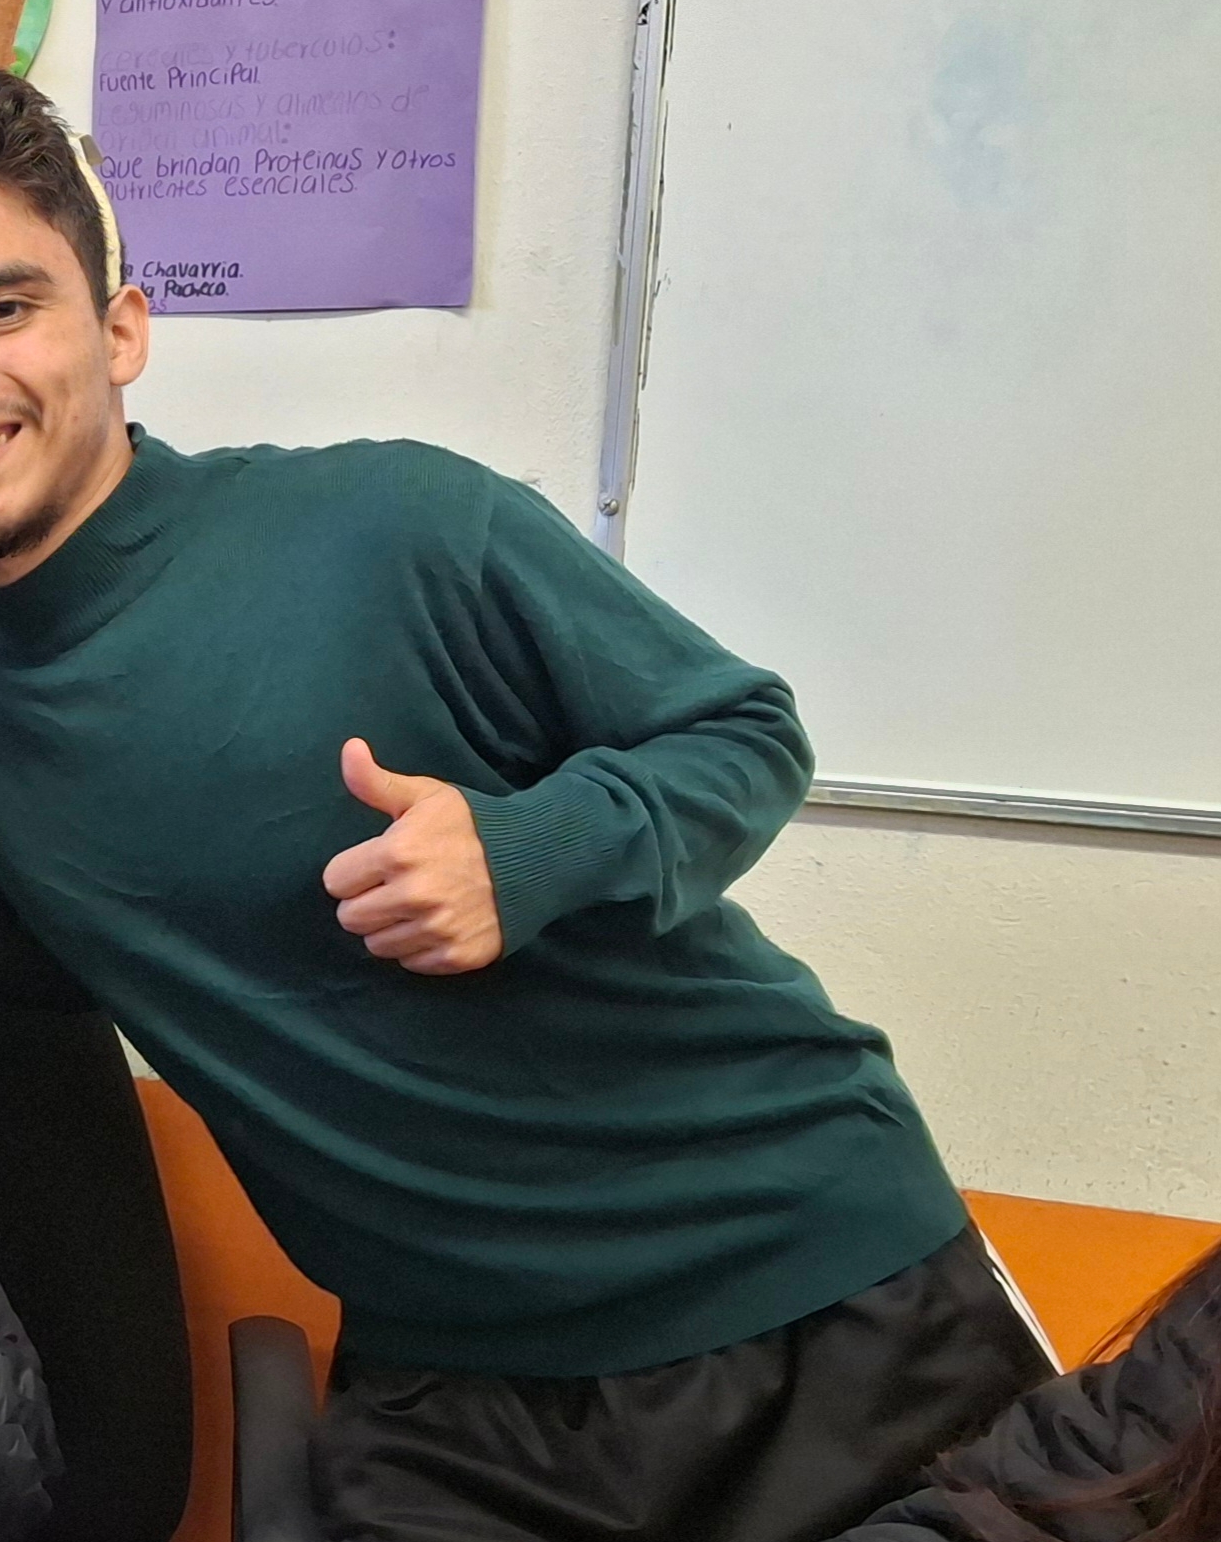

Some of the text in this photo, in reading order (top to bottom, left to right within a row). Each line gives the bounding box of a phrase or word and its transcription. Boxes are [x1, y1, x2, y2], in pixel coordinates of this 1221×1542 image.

[100, 155, 143, 179] Que
[156, 152, 240, 178] brindan
[104, 178, 207, 201] nutrientes
